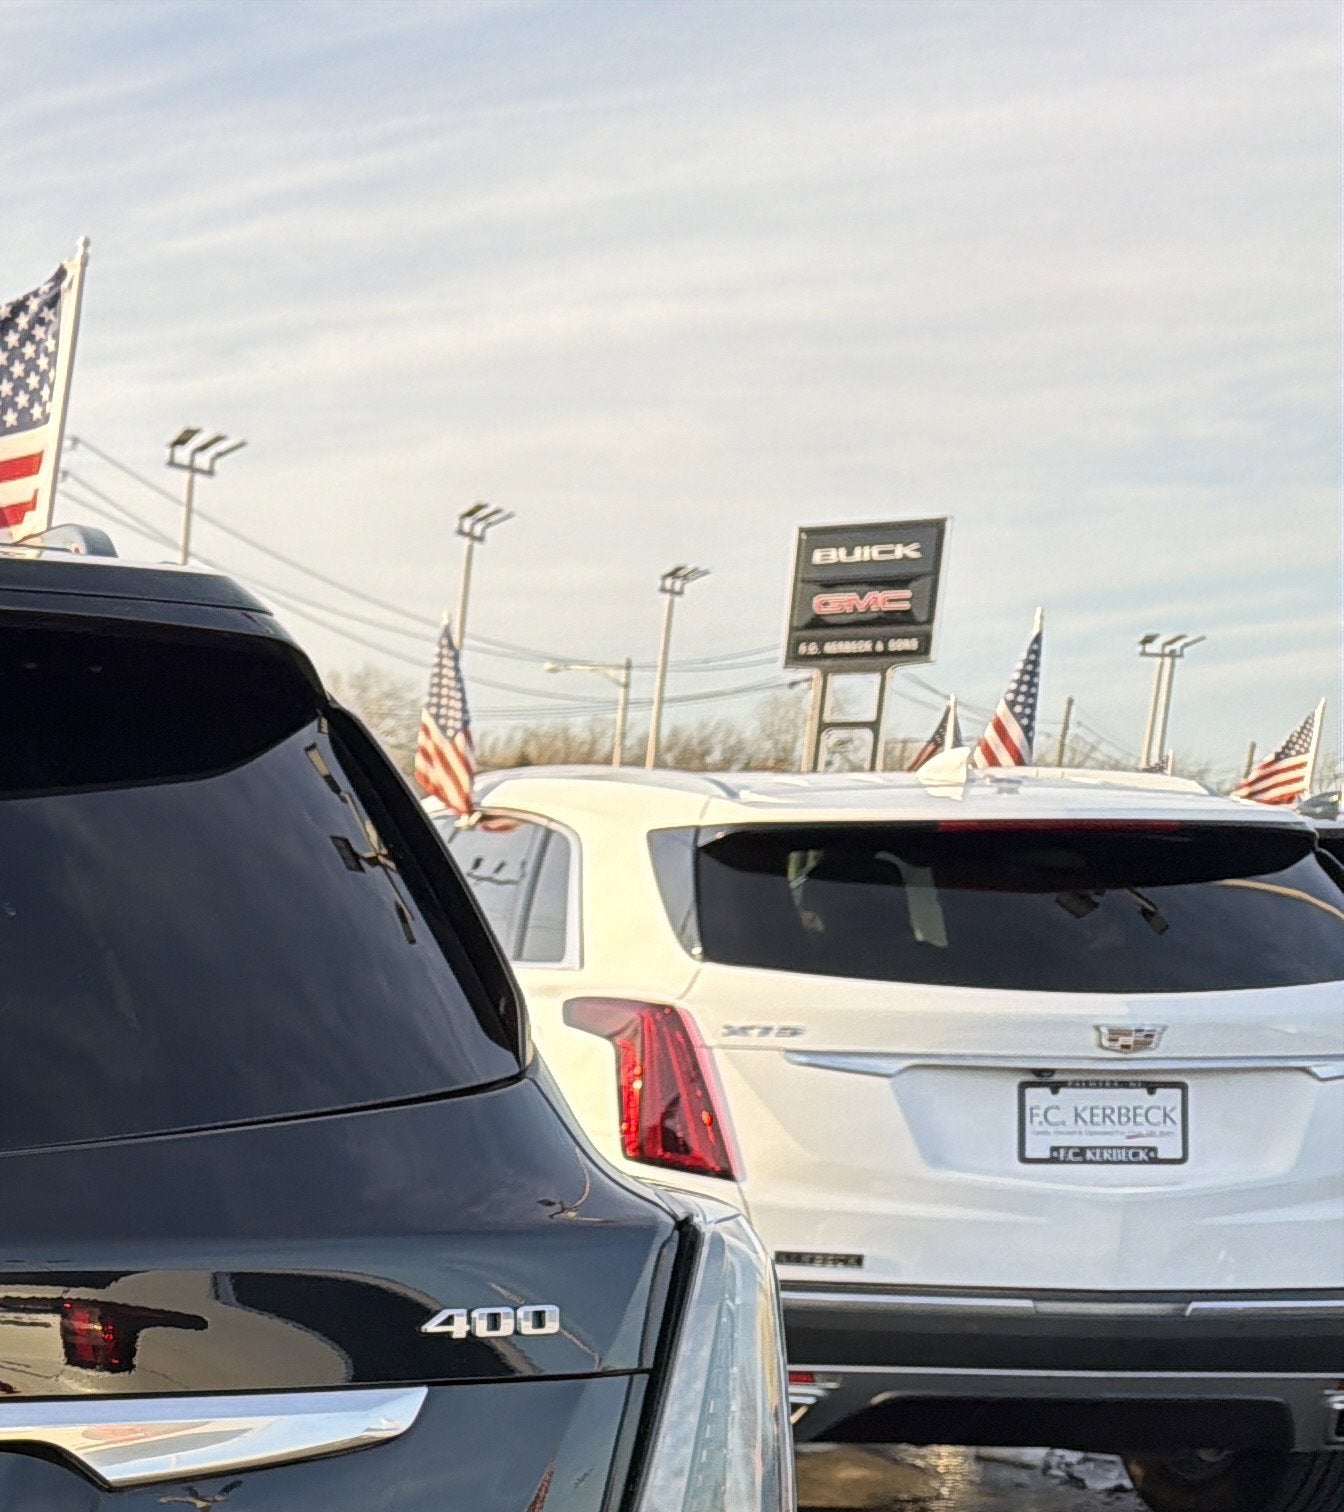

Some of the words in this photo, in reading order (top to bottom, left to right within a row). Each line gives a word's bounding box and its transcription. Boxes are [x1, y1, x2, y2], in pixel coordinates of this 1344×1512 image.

[812, 542, 922, 564] BUICK
[812, 589, 913, 615] GMC
[1029, 1104, 1066, 1127] F.C.
[1074, 1104, 1177, 1127] KERBECK
[420, 1304, 561, 1340] 400
